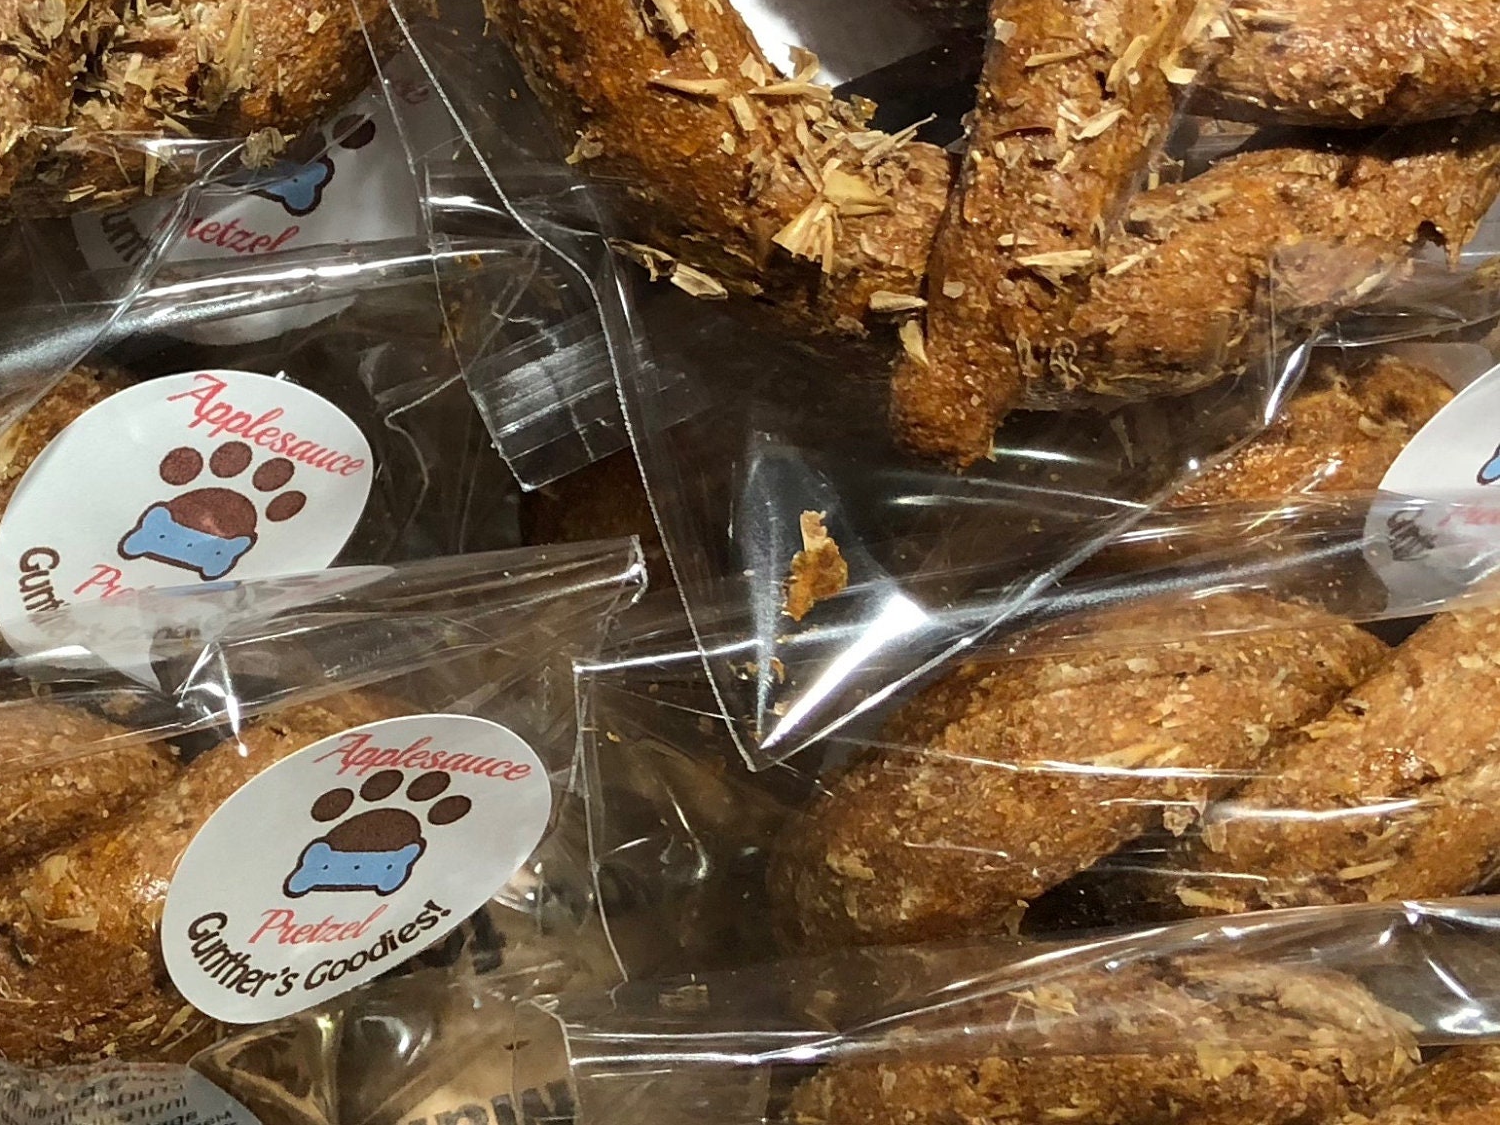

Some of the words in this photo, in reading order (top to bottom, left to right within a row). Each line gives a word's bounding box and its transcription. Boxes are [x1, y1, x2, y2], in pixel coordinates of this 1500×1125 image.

[167, 372, 366, 479] Applesauce
[313, 732, 533, 782] Applesauce
[187, 911, 300, 998] Gunther's
[303, 899, 452, 991] Goodies!
[247, 903, 390, 946] Pretzel
